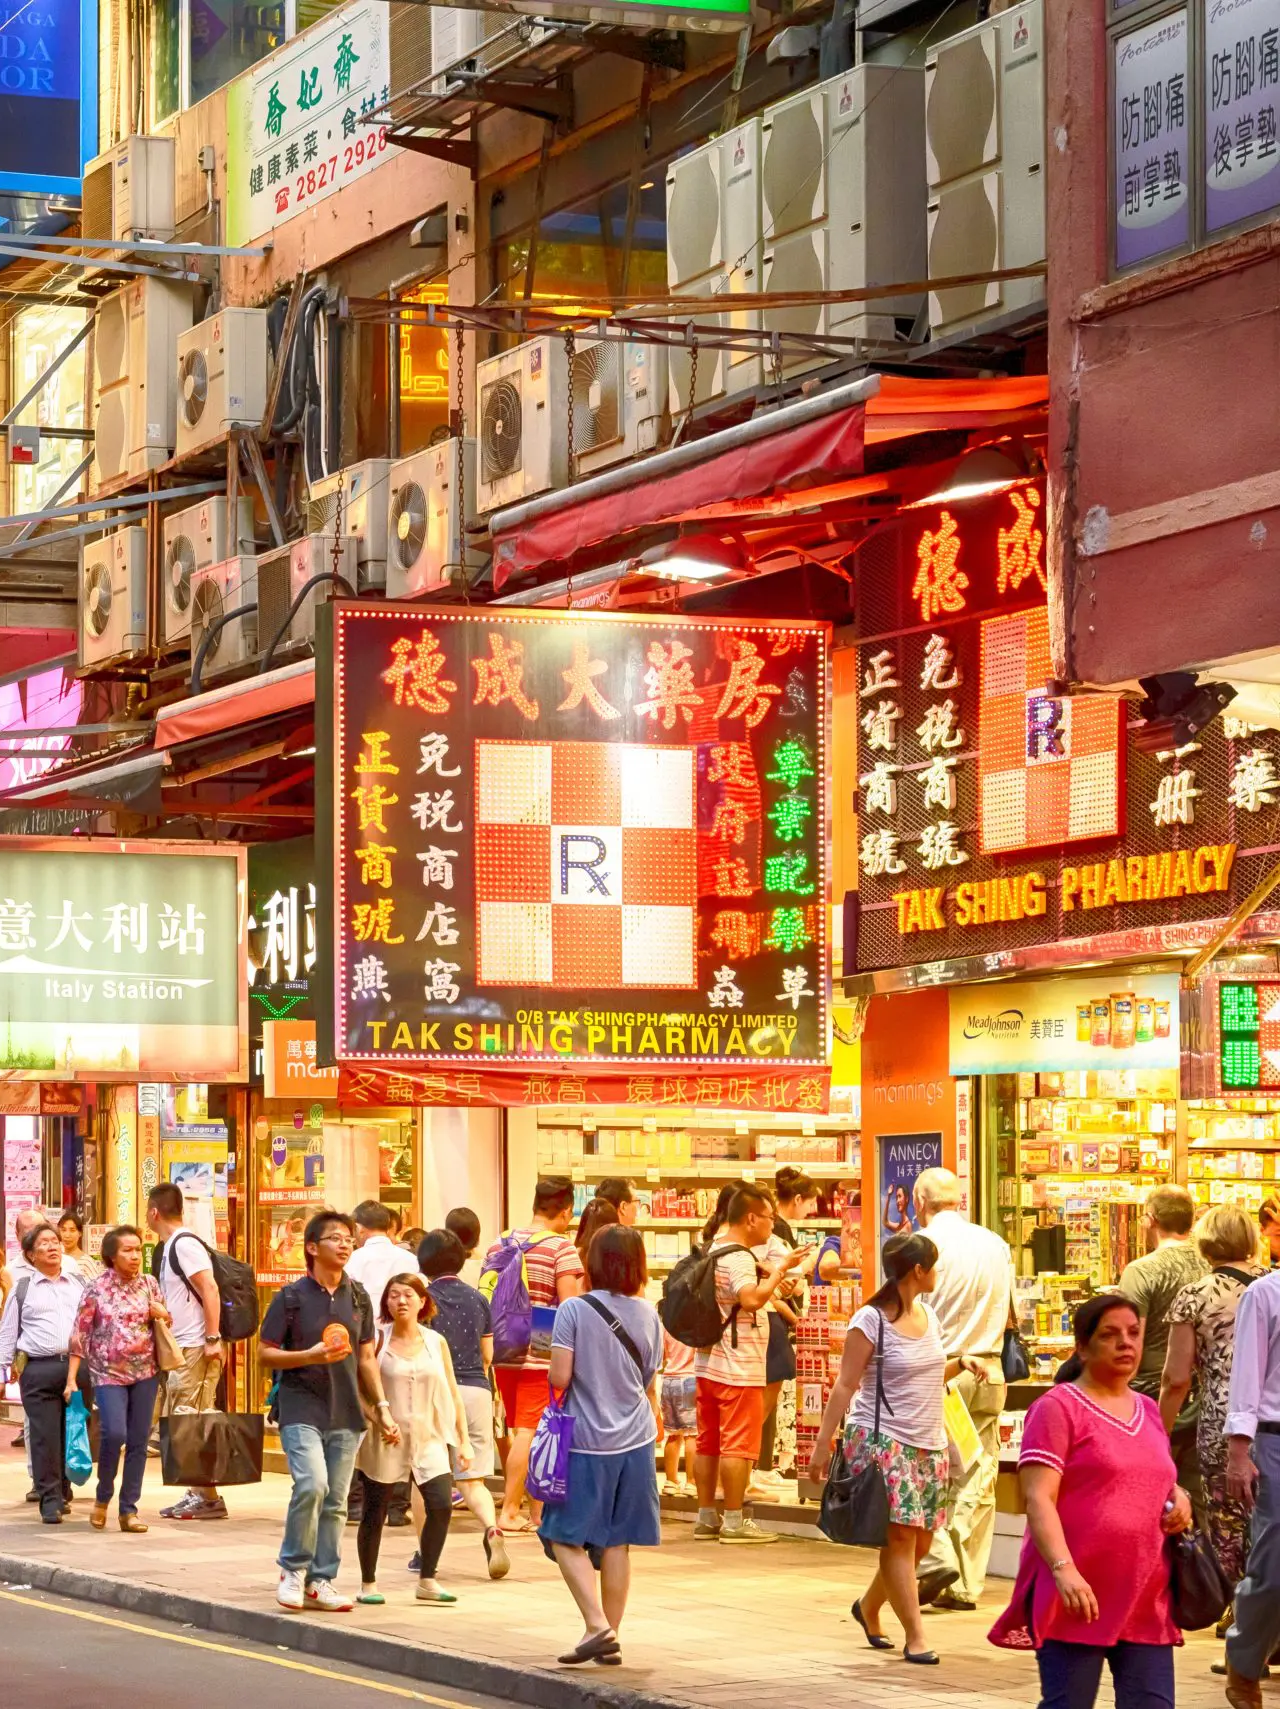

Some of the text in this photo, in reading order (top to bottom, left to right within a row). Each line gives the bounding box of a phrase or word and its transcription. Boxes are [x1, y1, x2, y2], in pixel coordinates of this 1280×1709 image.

[1211, 27, 1279, 112] 防腳痛
[1121, 73, 1185, 153] 防腳痛
[1213, 104, 1277, 178] 後掌墊
[297, 126, 388, 202] 2827 2928
[1124, 148, 1181, 217] 前掌墊
[382, 628, 782, 729] 德成大藥房
[859, 650, 907, 877] 正貨商號
[350, 731, 405, 946] 正貨商號
[893, 844, 1237, 935] TAK SHING PHARMACY
[1164, 927, 1196, 944] SHING
[45, 979, 183, 1002] Italy Station
[516, 1010, 544, 1025] O/B
[547, 1011, 579, 1026] TAK
[732, 1014, 799, 1030] LIMITED
[367, 1020, 799, 1057] TAK SHING PHARMACY
[991, 1031, 1019, 1039] Nutrition
[874, 1076, 945, 1105] mannings
[889, 1142, 939, 1162] ANNECY
